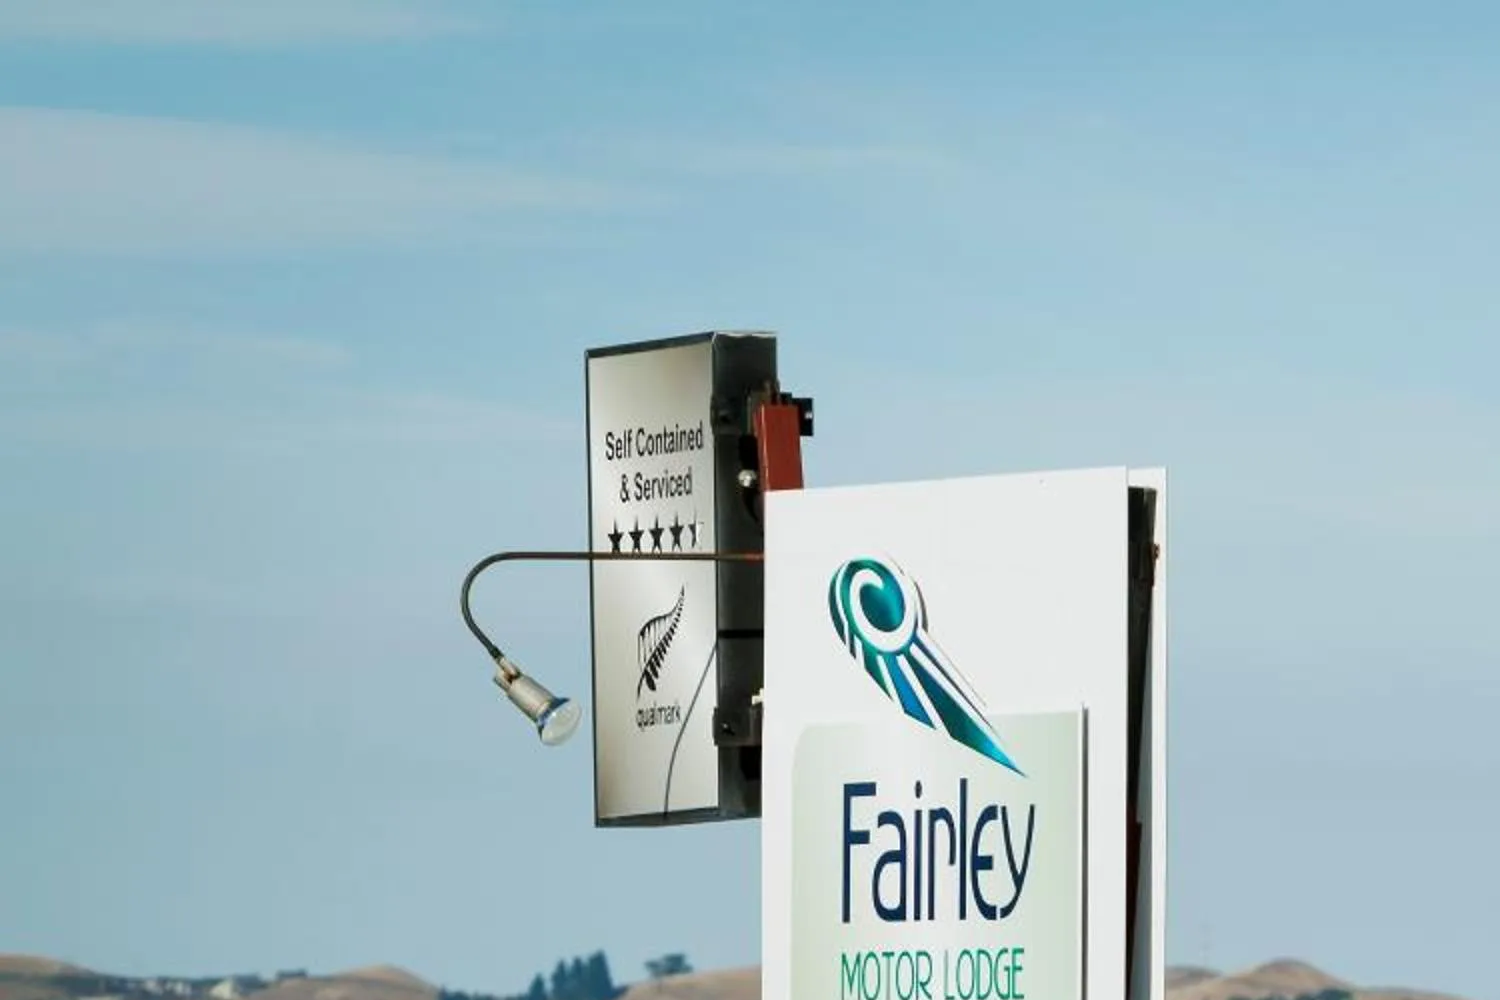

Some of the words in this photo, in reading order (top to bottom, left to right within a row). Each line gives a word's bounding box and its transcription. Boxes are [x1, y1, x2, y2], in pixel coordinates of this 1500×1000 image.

[604, 428, 633, 461] Self
[636, 419, 705, 457] Contained
[620, 473, 631, 503] &
[633, 466, 693, 501] Serviced
[636, 699, 681, 732] qualmark
[842, 778, 1036, 923] Fairley
[943, 947, 1025, 1000] LODGE
